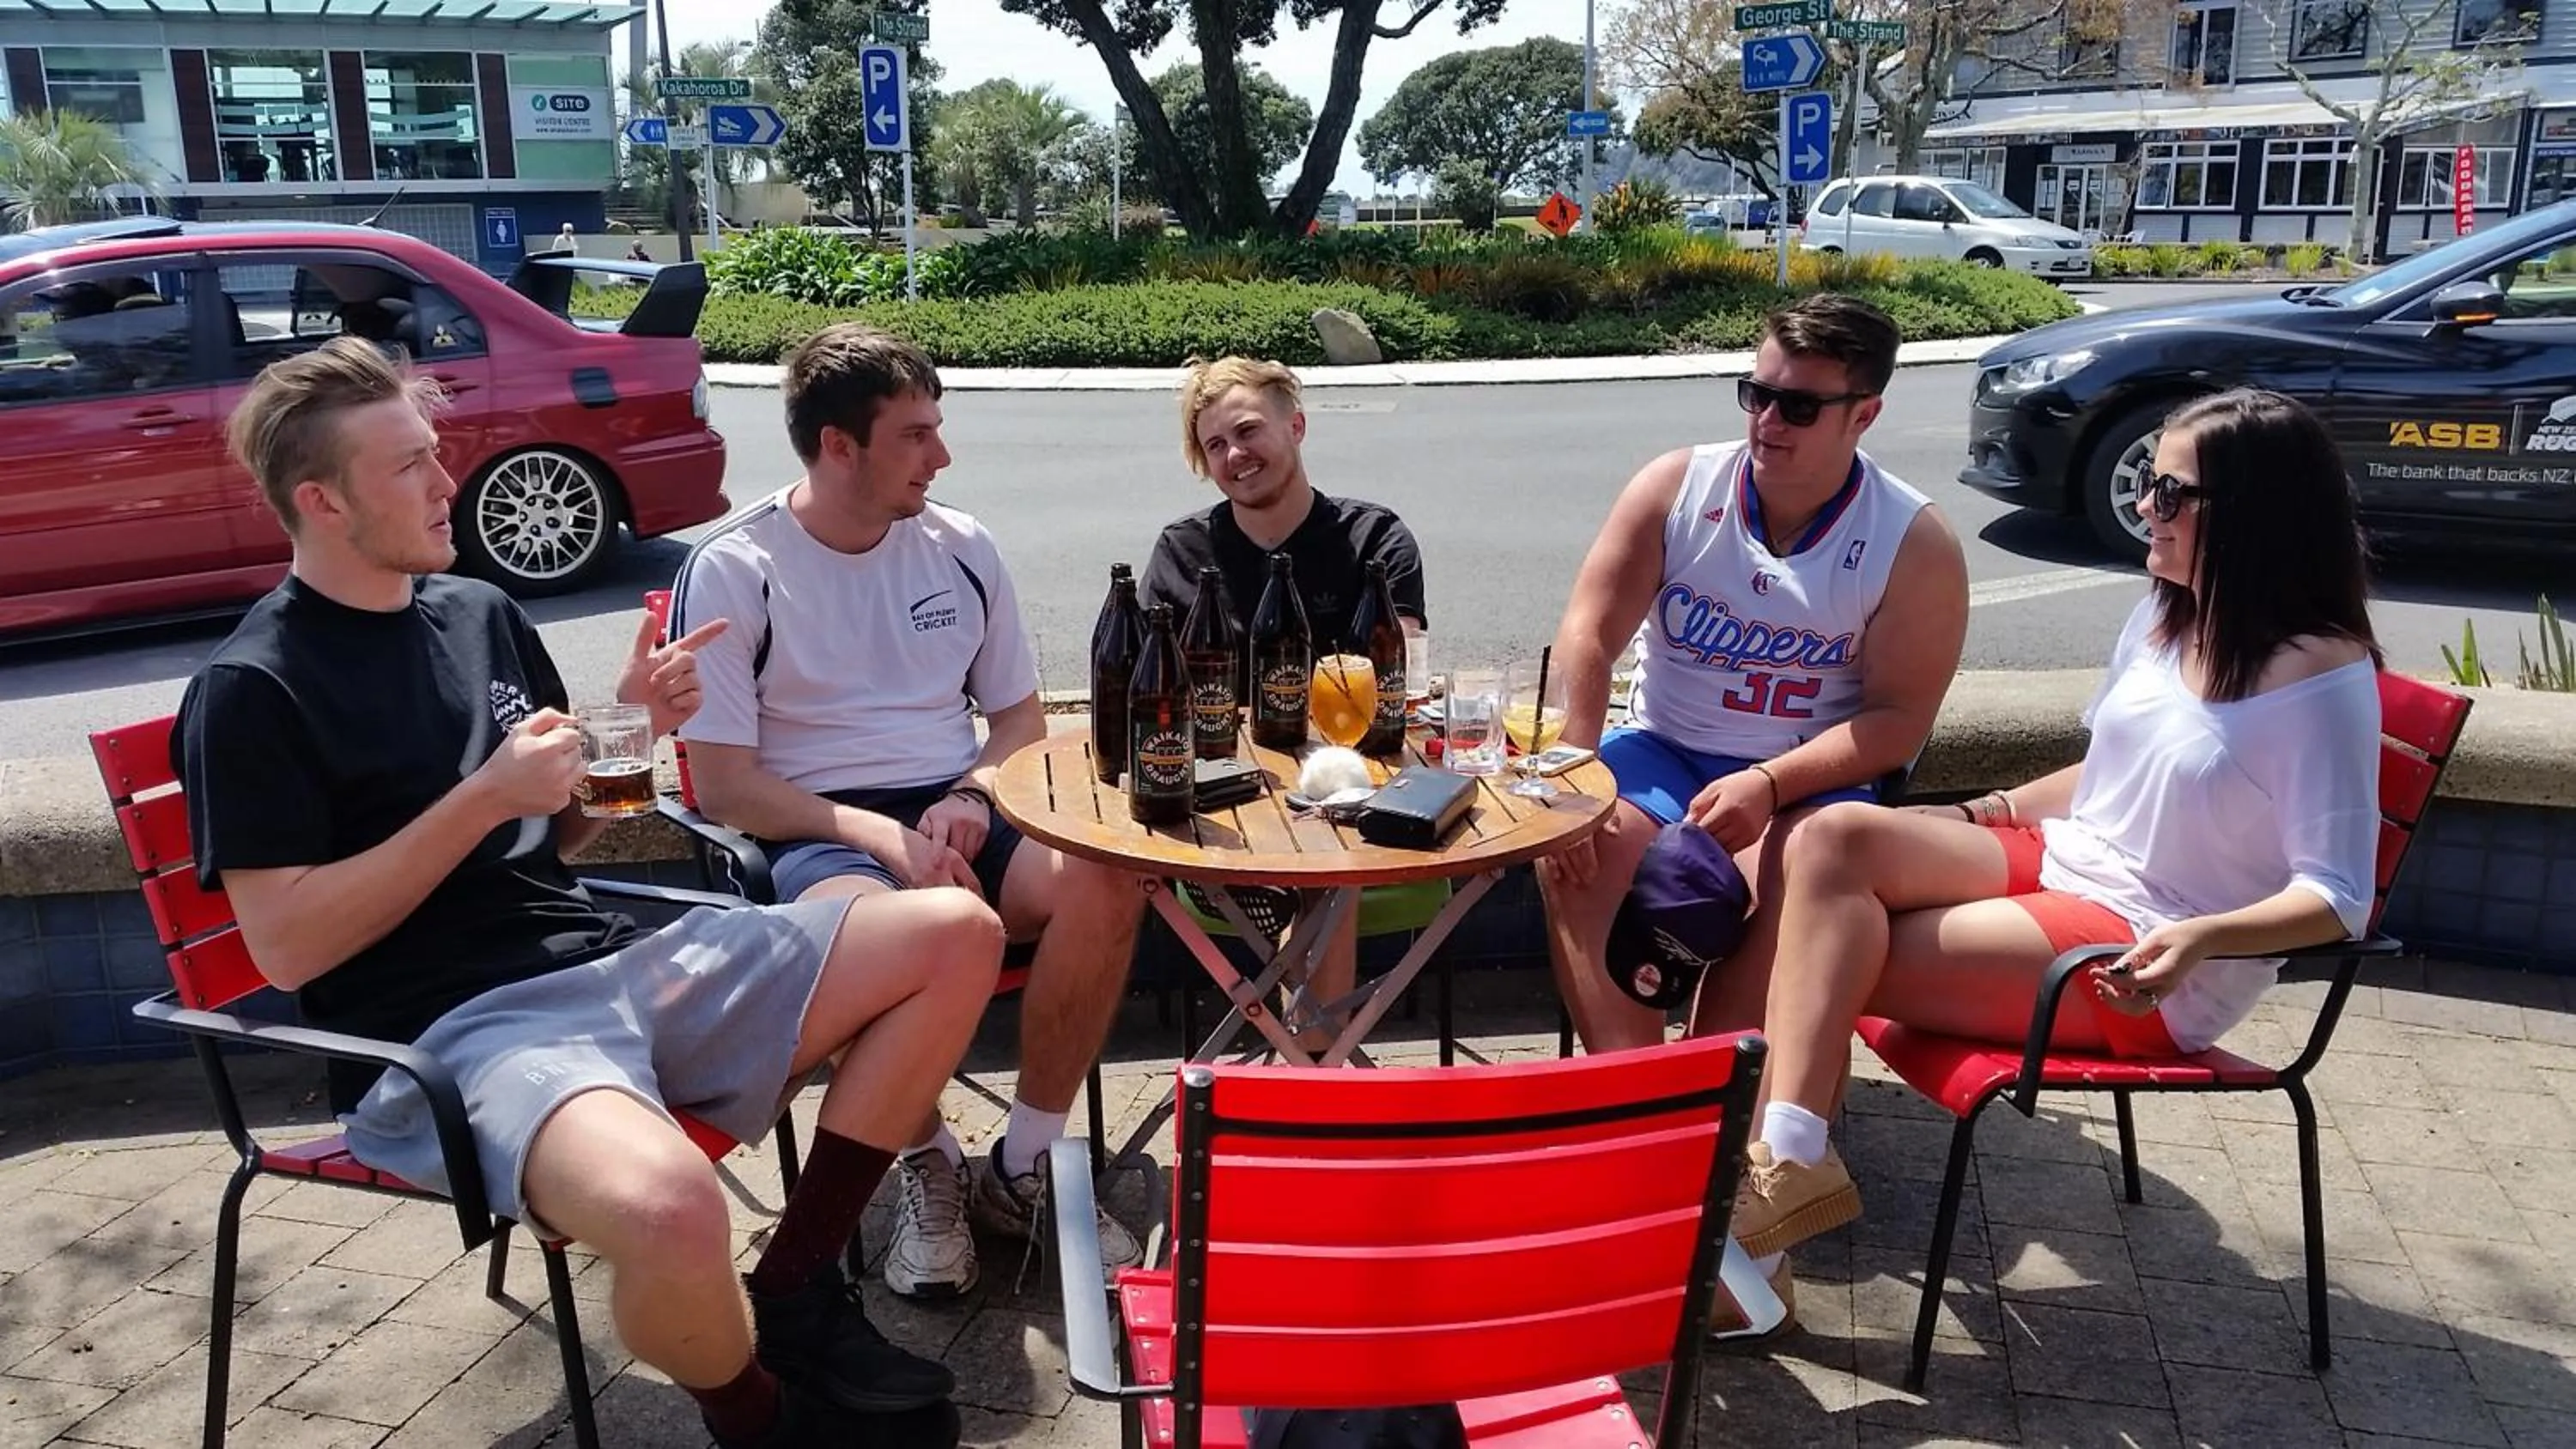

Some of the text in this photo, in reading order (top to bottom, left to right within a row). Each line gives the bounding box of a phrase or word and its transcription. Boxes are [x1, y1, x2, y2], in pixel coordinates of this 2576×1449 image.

[1741, 2, 1826, 27] George St
[878, 16, 927, 38] The Strand
[1832, 22, 1901, 40] The Strand
[869, 56, 891, 94] P
[730, 80, 744, 95] Dr
[1797, 103, 1821, 137] P
[2390, 421, 2501, 450] ASB
[2537, 425, 2561, 433] NEW
[2366, 462, 2398, 479] The
[2402, 464, 2444, 480] bank
[2447, 466, 2482, 482] that
[2487, 467, 2538, 483] backs
[2543, 469, 2570, 484] NZ
[914, 616, 957, 633] CRICKET
[1658, 582, 1856, 671] Clippers
